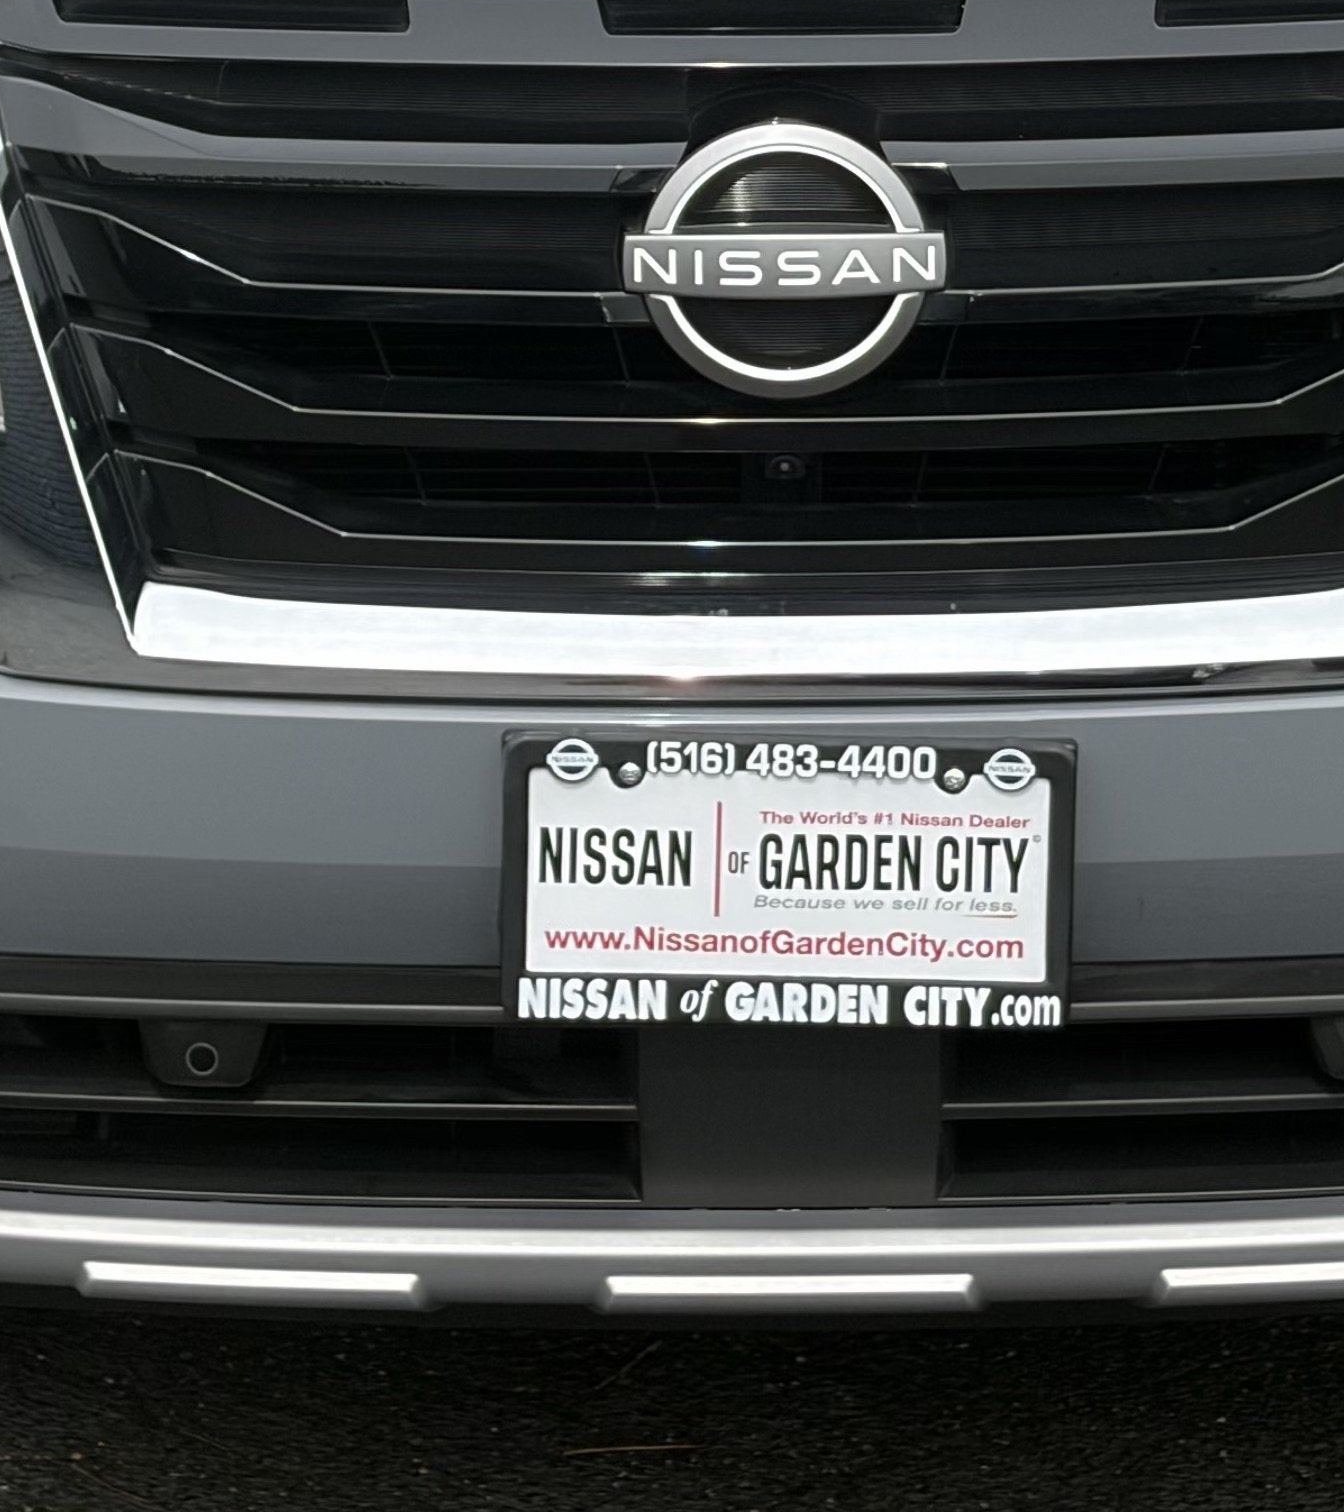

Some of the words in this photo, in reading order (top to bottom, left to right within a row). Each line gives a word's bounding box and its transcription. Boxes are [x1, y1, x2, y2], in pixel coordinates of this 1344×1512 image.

[633, 246, 936, 286] NISSAN
[551, 755, 594, 764] NISSAN
[646, 741, 736, 776] (516)
[745, 743, 937, 779] 483-4400
[988, 765, 1032, 774] NISSAN
[760, 811, 794, 825] The
[799, 811, 868, 825] World's
[874, 812, 894, 825] #1
[901, 813, 963, 827] Nissan
[969, 814, 1031, 829] Dealer
[539, 826, 692, 887] NISSAN
[728, 851, 750, 874] OF
[759, 833, 922, 891] GARDEN
[936, 835, 1029, 893] CITY
[754, 895, 846, 909] Because
[854, 897, 885, 910] we
[892, 896, 928, 910] sell
[934, 896, 963, 911] for
[969, 897, 1017, 913] less.
[545, 926, 1024, 962] www.NissanofGardenCity.com
[518, 977, 667, 1020] NISSAN
[680, 979, 719, 1022] of
[724, 981, 888, 1025] GARDEN
[904, 985, 1061, 1027] CITY.com
